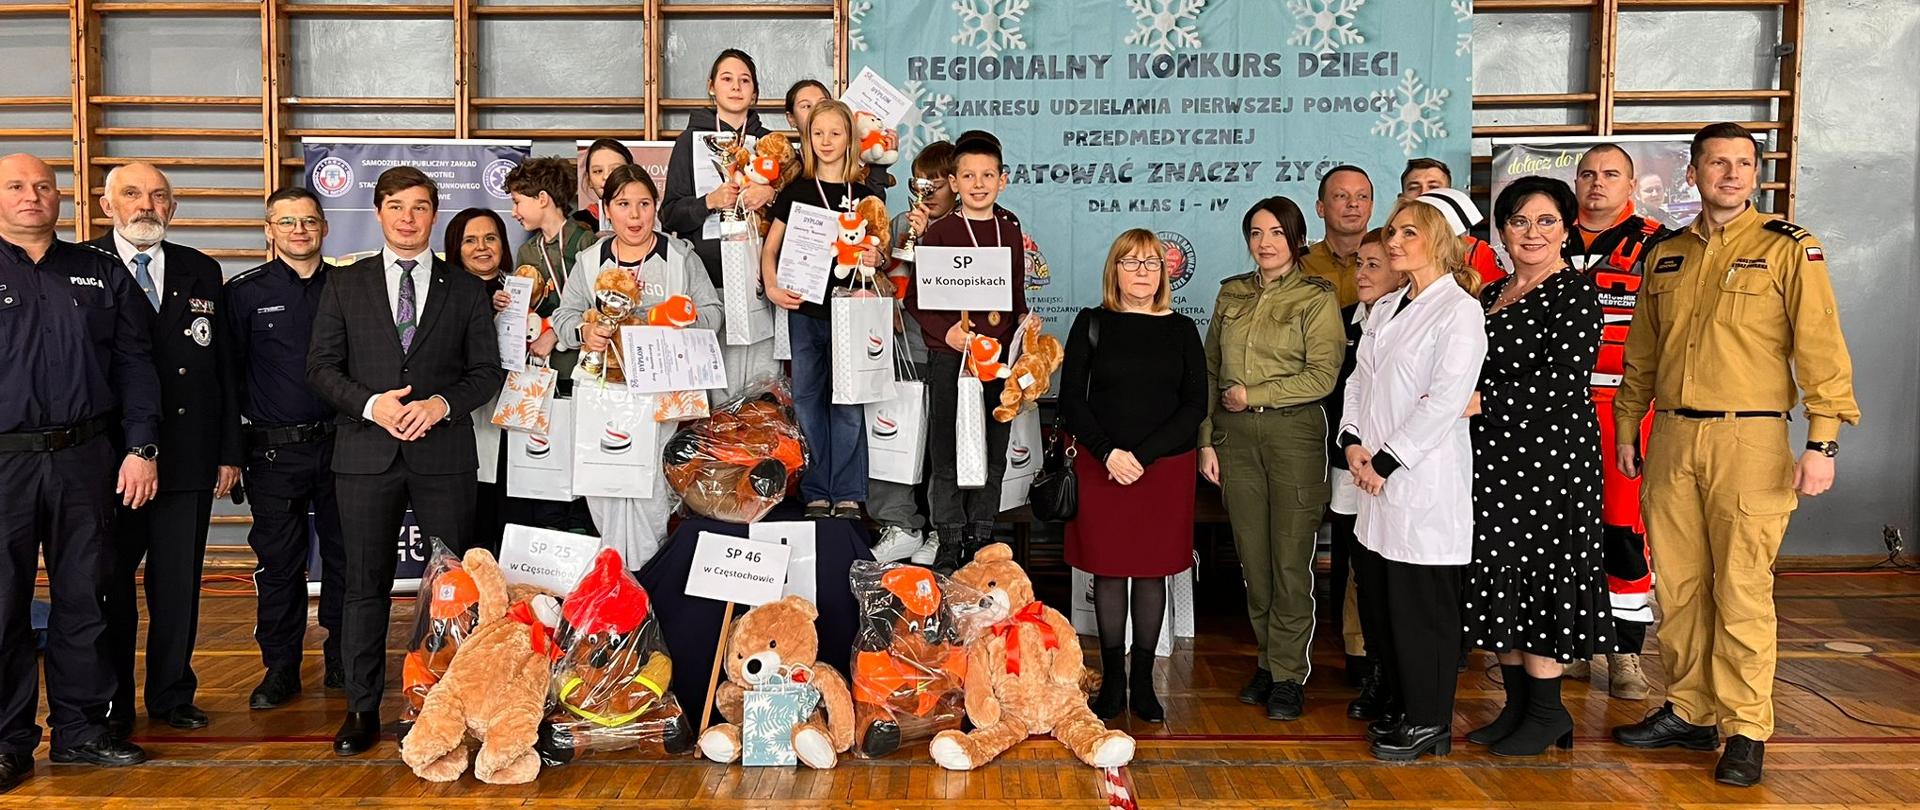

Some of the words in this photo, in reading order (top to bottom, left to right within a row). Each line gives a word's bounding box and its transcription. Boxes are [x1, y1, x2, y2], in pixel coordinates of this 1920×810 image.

[908, 54, 1112, 81] REGIONALNY
[1128, 53, 1282, 80] KONKURS
[1298, 51, 1398, 78] DZIECI
[922, 100, 937, 117] Z
[948, 99, 1040, 117] ZAKRESU
[1050, 98, 1171, 116] UDZIELANIA
[1181, 96, 1294, 114] PIERWSZEJ
[1303, 95, 1400, 113] POMOCY
[1063, 128, 1256, 147] PRZEDMEDYCZNEJ
[1507, 154, 1552, 175] dołącz
[1555, 150, 1572, 168] do
[1148, 159, 1262, 184] ZNACZY
[1088, 198, 1121, 213] DLA
[1129, 198, 1172, 213] KLAS
[1210, 197, 1230, 212] IV
[952, 255, 973, 269] SP
[921, 277, 932, 285] w
[935, 275, 1006, 288] Konopiskach
[1026, 296, 1037, 304] NT
[1171, 295, 1187, 305] CJA
[1194, 318, 1211, 326] OCY
[529, 541, 548, 555] SP
[554, 545, 572, 559] 25
[725, 547, 743, 560] SP
[745, 550, 763, 564] 46
[510, 562, 519, 571] w
[520, 562, 577, 578] Częstochow
[703, 565, 712, 573] w
[713, 565, 776, 584] Częstochowie
